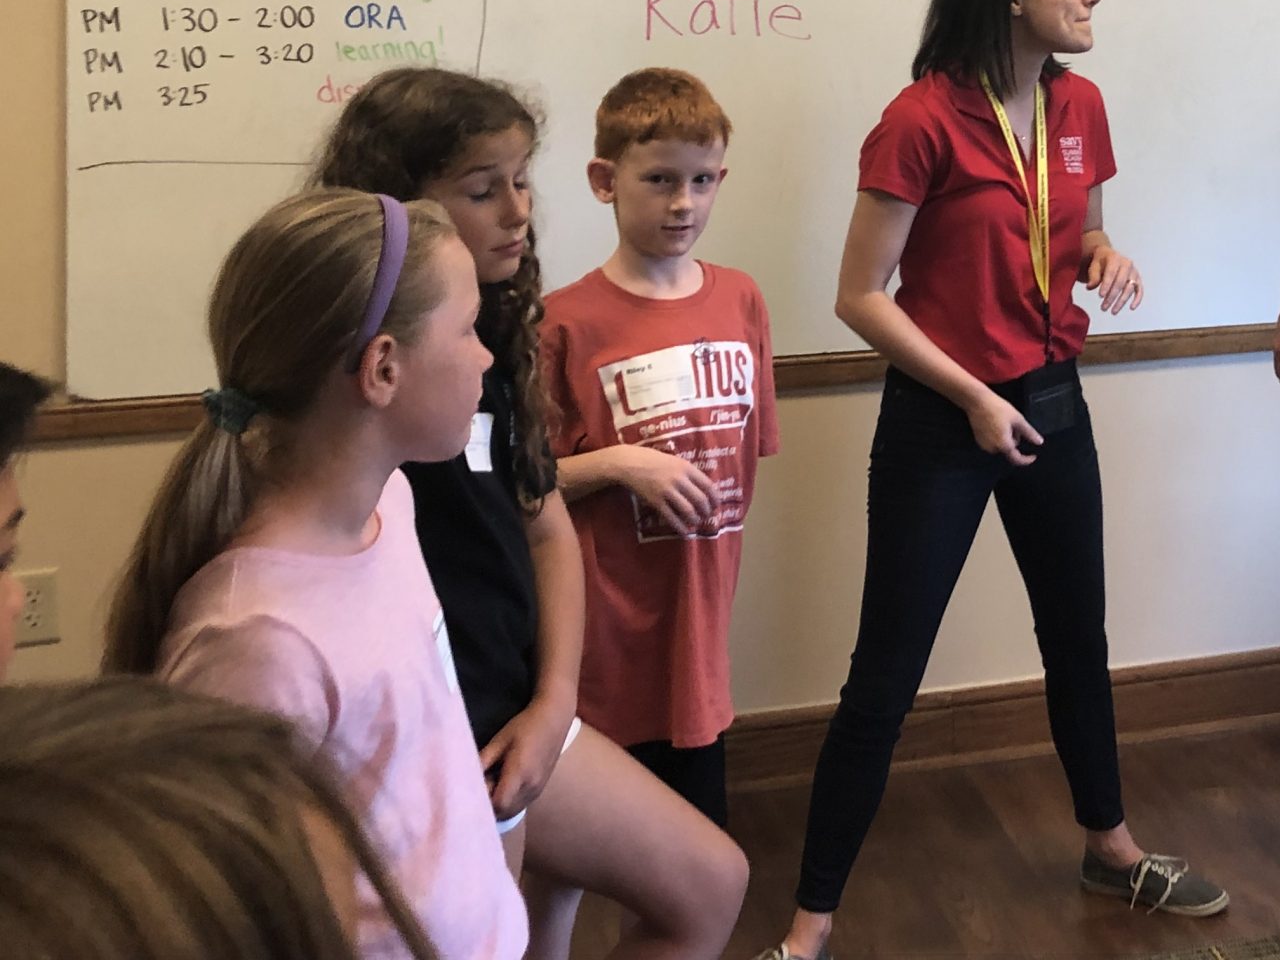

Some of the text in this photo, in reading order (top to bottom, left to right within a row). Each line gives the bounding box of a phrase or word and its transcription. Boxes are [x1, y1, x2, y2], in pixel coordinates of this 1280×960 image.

[81, 7, 121, 33] PM
[161, 6, 218, 32] 1:30
[255, 5, 315, 29] 2:00
[344, 3, 407, 31] ORA
[83, 48, 123, 74] PM
[154, 45, 206, 72] 2:10
[256, 43, 314, 65] 3:20
[87, 91, 122, 112] PM
